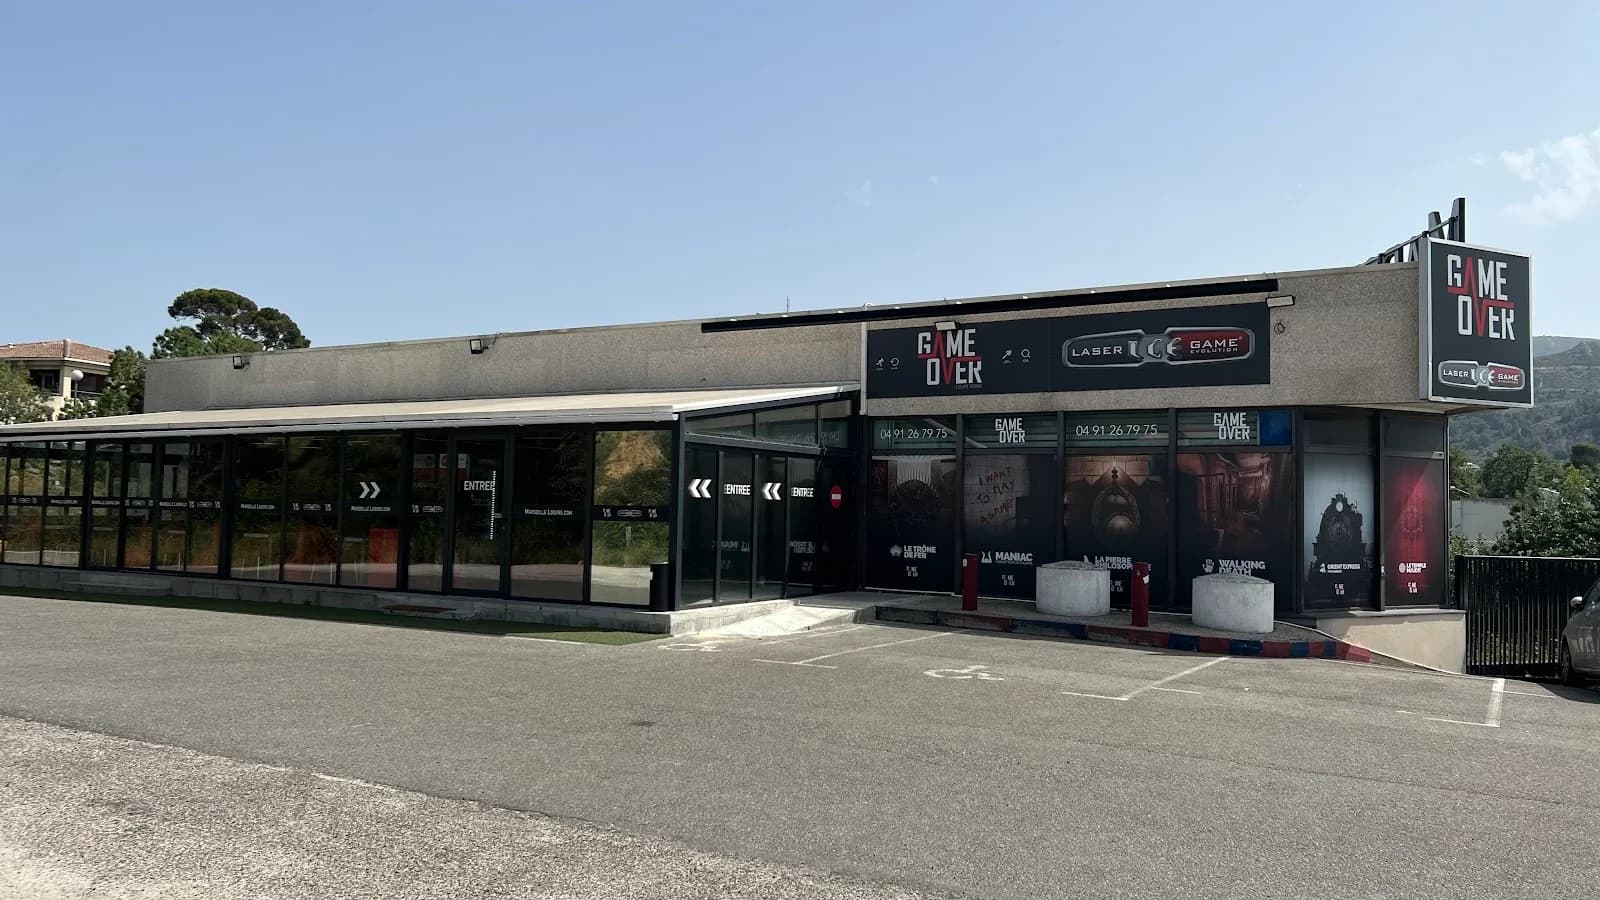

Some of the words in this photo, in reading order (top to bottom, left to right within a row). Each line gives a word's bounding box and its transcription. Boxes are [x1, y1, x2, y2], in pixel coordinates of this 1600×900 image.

[1448, 254, 1508, 301] GAME
[1458, 295, 1515, 340] OVER
[918, 329, 976, 358] GAME
[1072, 345, 1123, 357] LASER
[1189, 338, 1239, 349] GAME
[1189, 347, 1238, 355] EVOLUTION
[927, 358, 982, 386] OVER
[1443, 369, 1470, 378] LASER
[995, 418, 1023, 431] GAME
[1213, 412, 1247, 427] GAME
[880, 429, 891, 439] 04
[894, 429, 904, 439] 91
[908, 429, 920, 439] 26
[922, 428, 933, 438] 79
[936, 428, 948, 438] 75
[1075, 425, 1090, 436] 04
[1092, 425, 1105, 436] 91
[1109, 425, 1123, 436] 26
[1126, 425, 1141, 435] 79
[1144, 425, 1158, 435] 75
[1218, 427, 1250, 440] OVER
[999, 430, 1026, 443] OVER
[724, 484, 751, 495] ENTREE
[791, 487, 814, 497] ENTREE
[913, 544, 937, 553] TRÔNE
[904, 551, 913, 559] DE
[995, 551, 1033, 561] MANIAC
[1105, 556, 1132, 564] PIERRE
[1219, 559, 1266, 569] WALKING
[1219, 567, 1252, 576] DEATH
